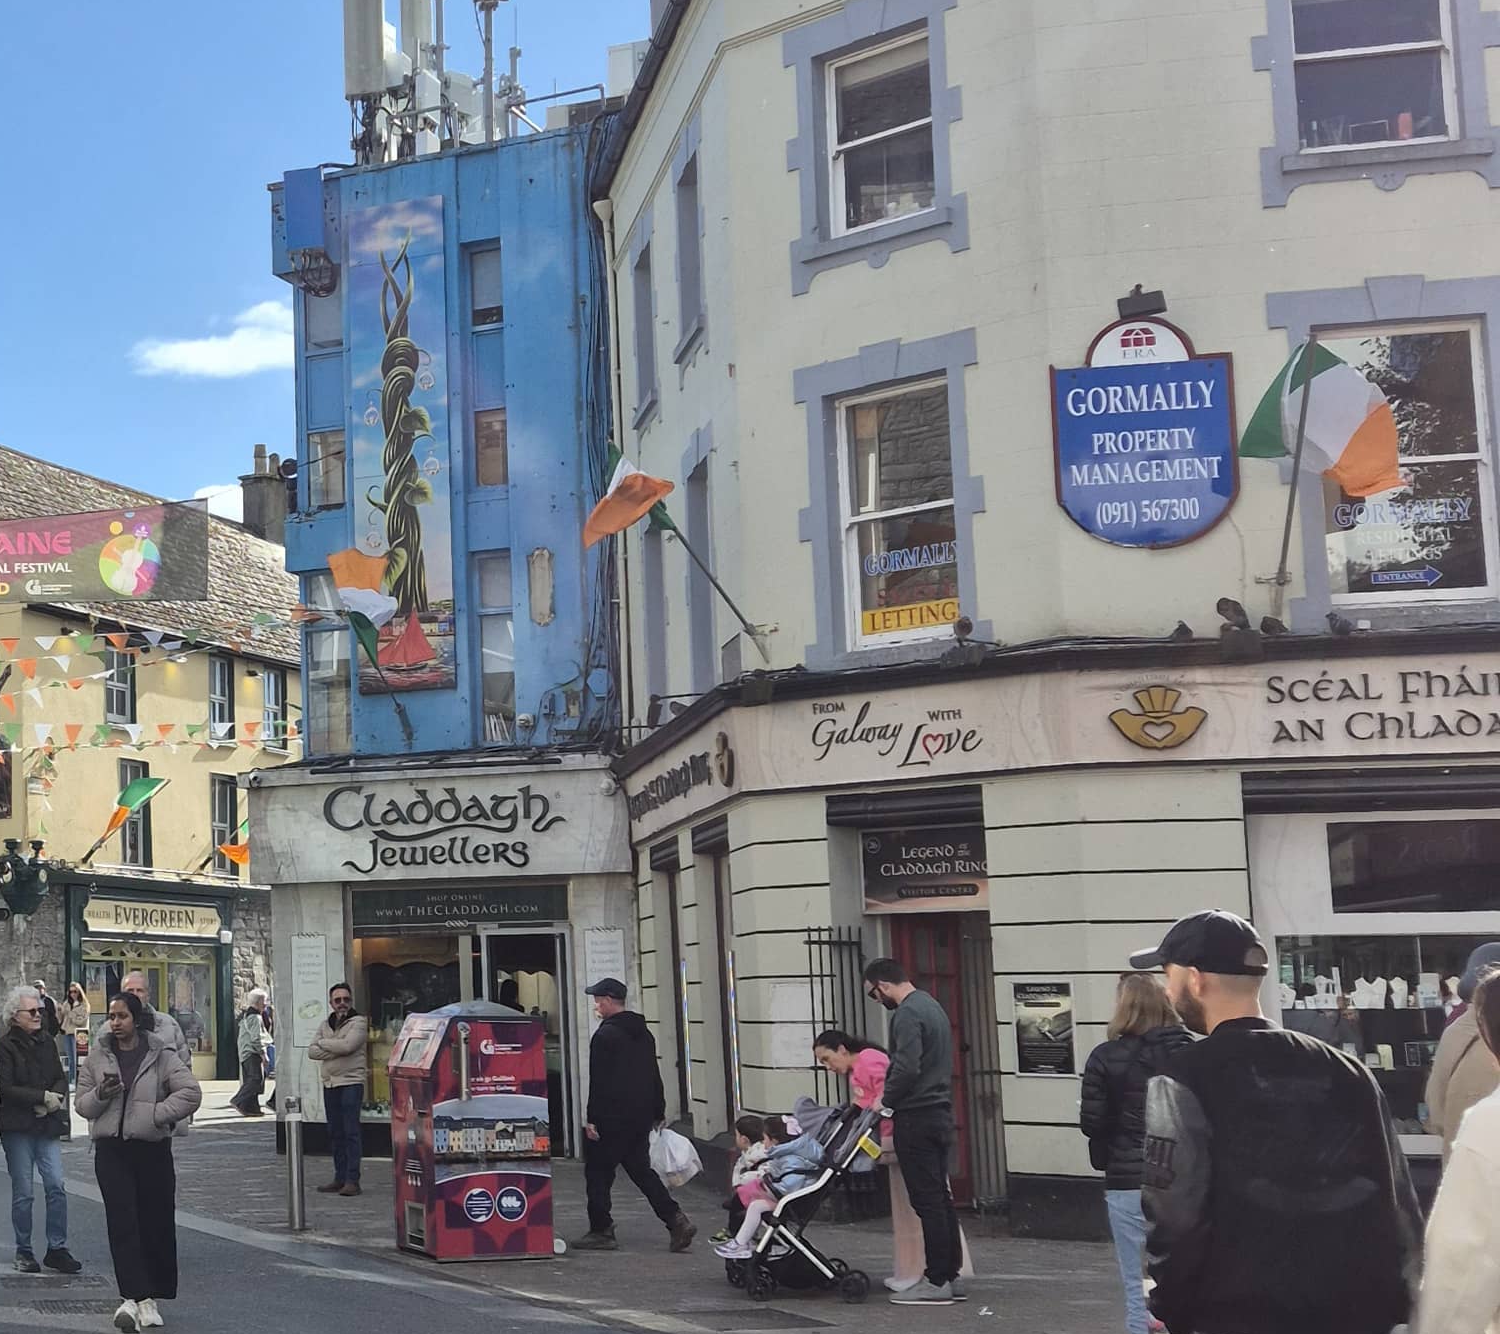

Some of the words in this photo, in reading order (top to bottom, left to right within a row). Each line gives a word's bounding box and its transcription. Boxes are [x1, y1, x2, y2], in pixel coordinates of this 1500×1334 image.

[1122, 349, 1157, 359] ERA
[1066, 380, 1215, 417] GORMALLY
[1091, 427, 1197, 455] PROPERTY
[1070, 456, 1222, 487] MANAGEMENT
[1095, 501, 1138, 530] (091)
[1141, 498, 1201, 524] 567300
[1332, 497, 1473, 530] GORMALLY
[14, 562, 73, 574] FESTIVAL
[1377, 571, 1426, 582] ENTRANCE
[869, 601, 957, 631] LETTING
[812, 701, 846, 715] FROM
[926, 708, 963, 722] WITH
[811, 701, 903, 762] Galway
[323, 784, 567, 842] Claddagh
[341, 835, 530, 874] Jewellers
[450, 892, 484, 902] ONLINE
[113, 904, 196, 929] EVERGREEN
